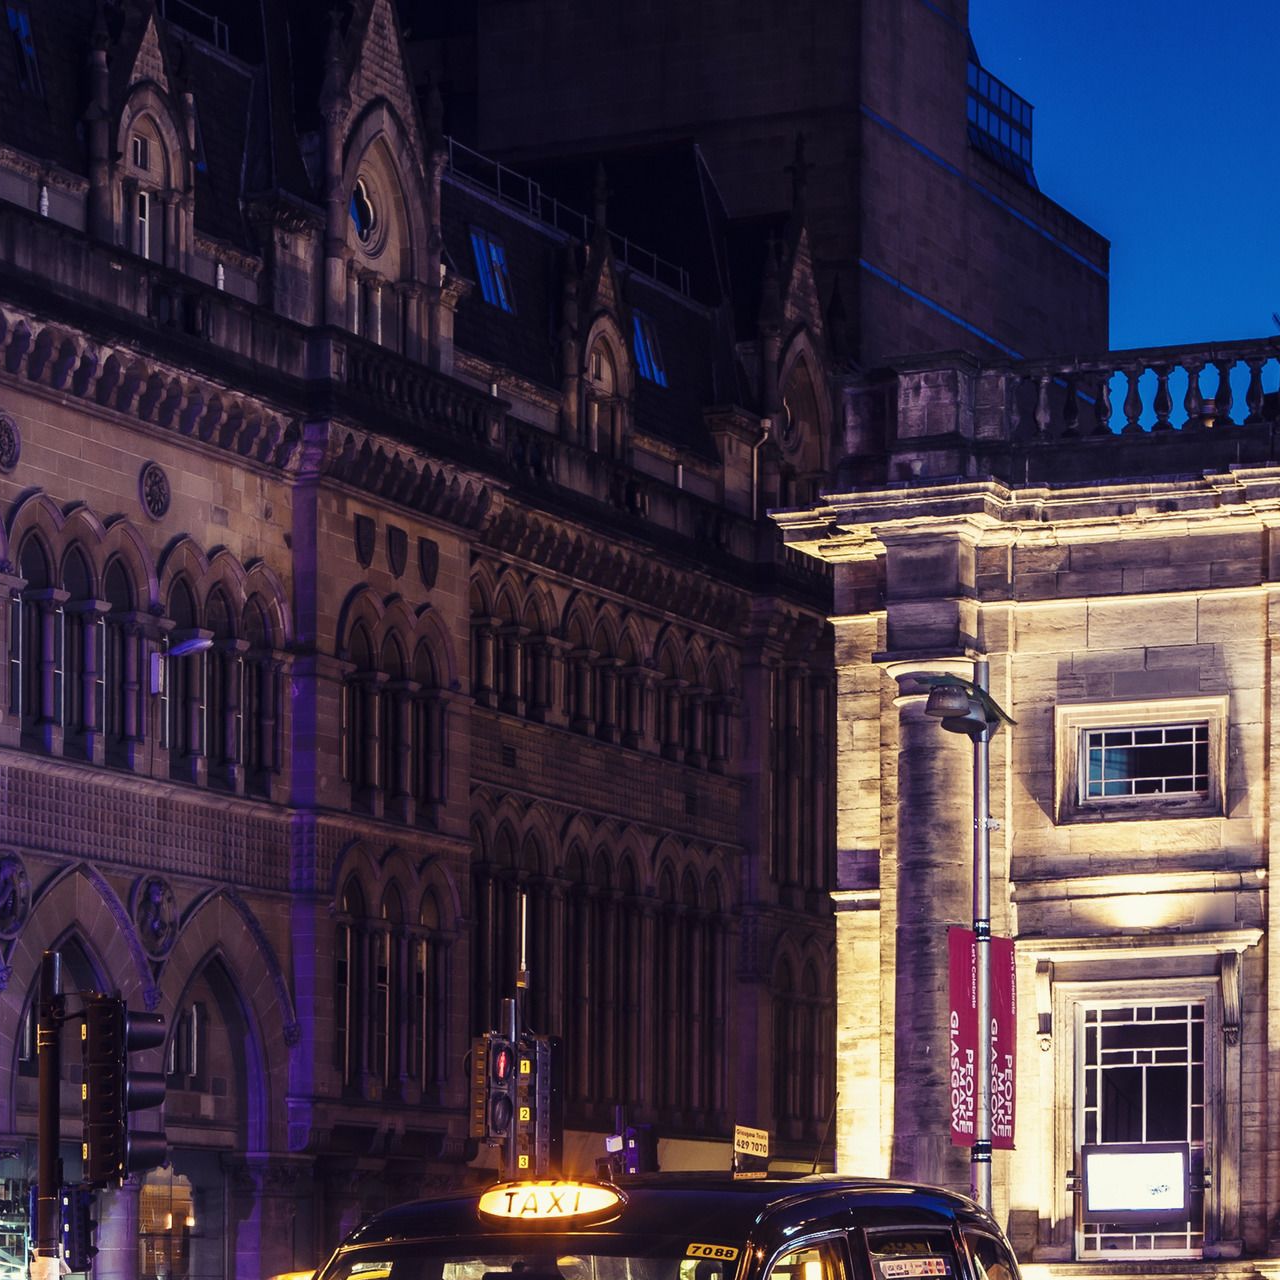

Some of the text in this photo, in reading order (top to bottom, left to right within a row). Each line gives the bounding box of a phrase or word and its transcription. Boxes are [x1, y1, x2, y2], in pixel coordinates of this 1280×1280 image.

[522, 1062, 528, 1072] 1
[950, 1010, 961, 1133] GLASGOW
[990, 1018, 999, 1136] GLASGOW
[521, 1109, 528, 1119] 2
[958, 1066, 967, 1134] MAKE
[965, 1049, 974, 1135] PEOPLE
[997, 1072, 1006, 1137] MAKE
[1004, 1054, 1013, 1138] PEOPLE
[520, 1157, 527, 1167] 3
[736, 1140, 767, 1153] 429 7070
[505, 1191, 581, 1215] TAXI
[691, 1245, 735, 1258] 7088
